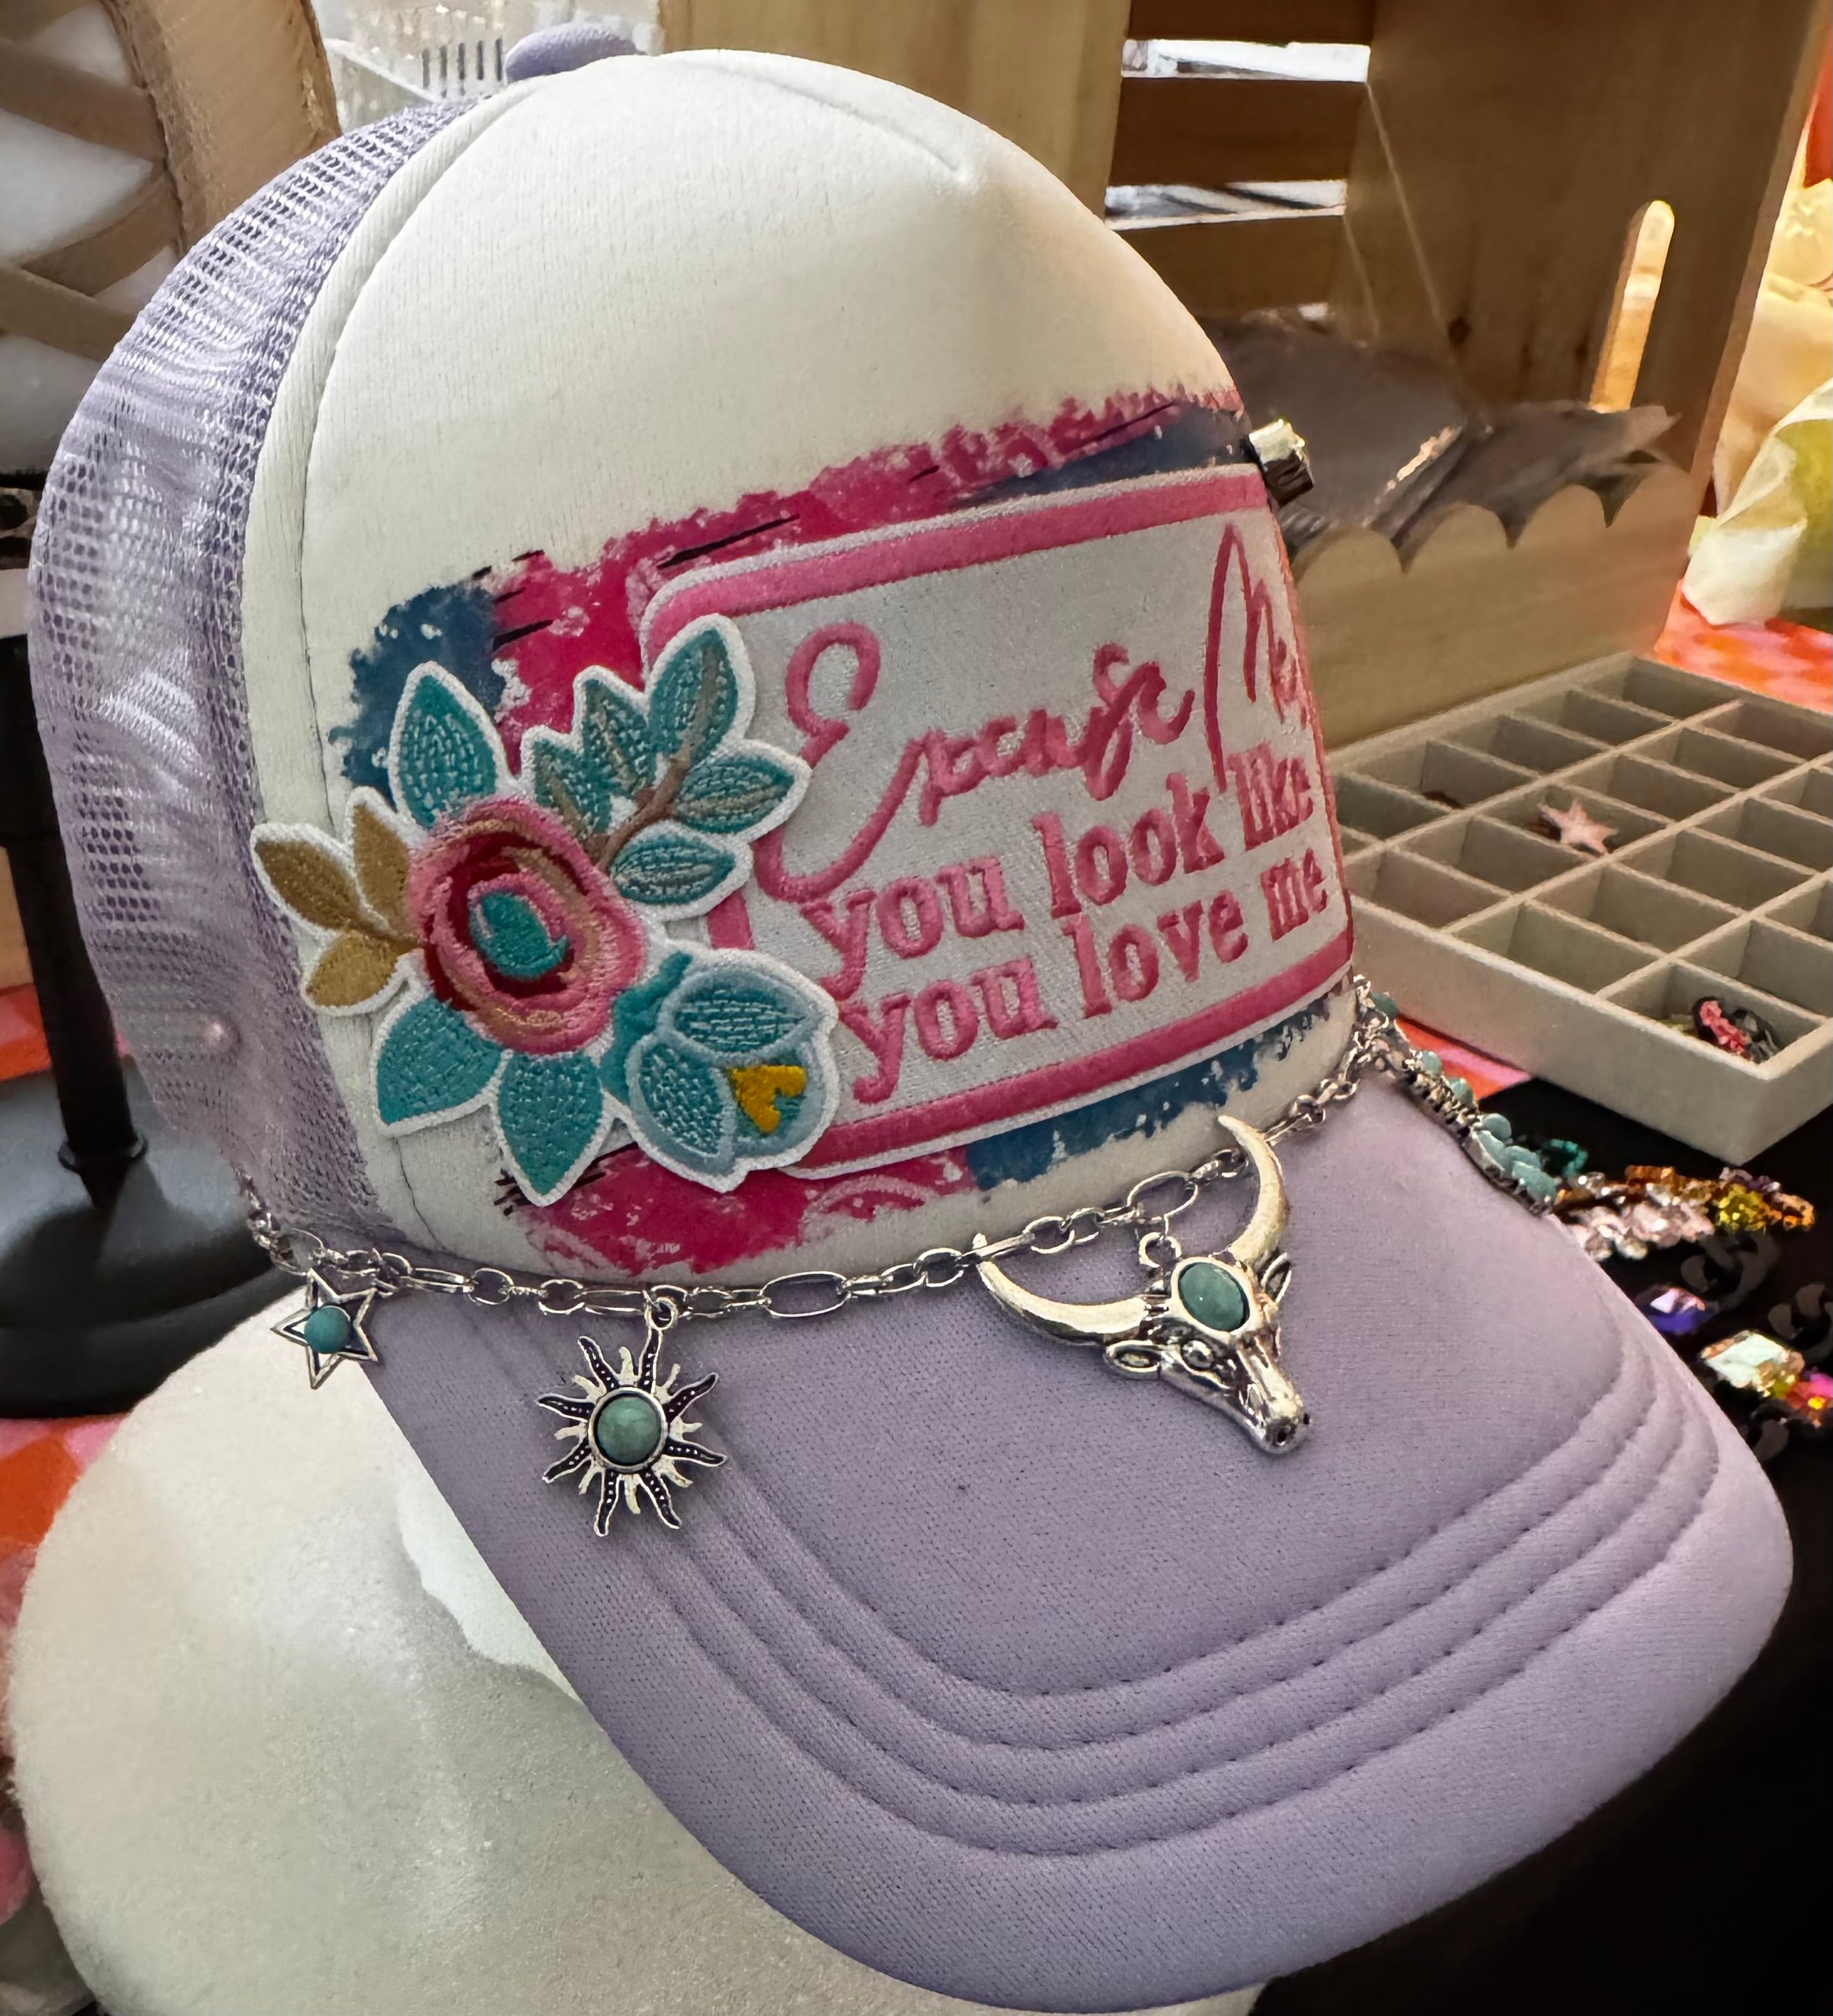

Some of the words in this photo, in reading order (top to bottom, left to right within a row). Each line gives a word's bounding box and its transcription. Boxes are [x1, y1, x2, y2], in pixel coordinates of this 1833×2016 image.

[753, 620, 1196, 904] Excuse
[801, 856, 1026, 1000] you
[1031, 772, 1226, 920] look
[1226, 740, 1314, 851] like
[838, 956, 1058, 1104] you
[1061, 889, 1248, 1019] love
[1260, 847, 1328, 942] me
